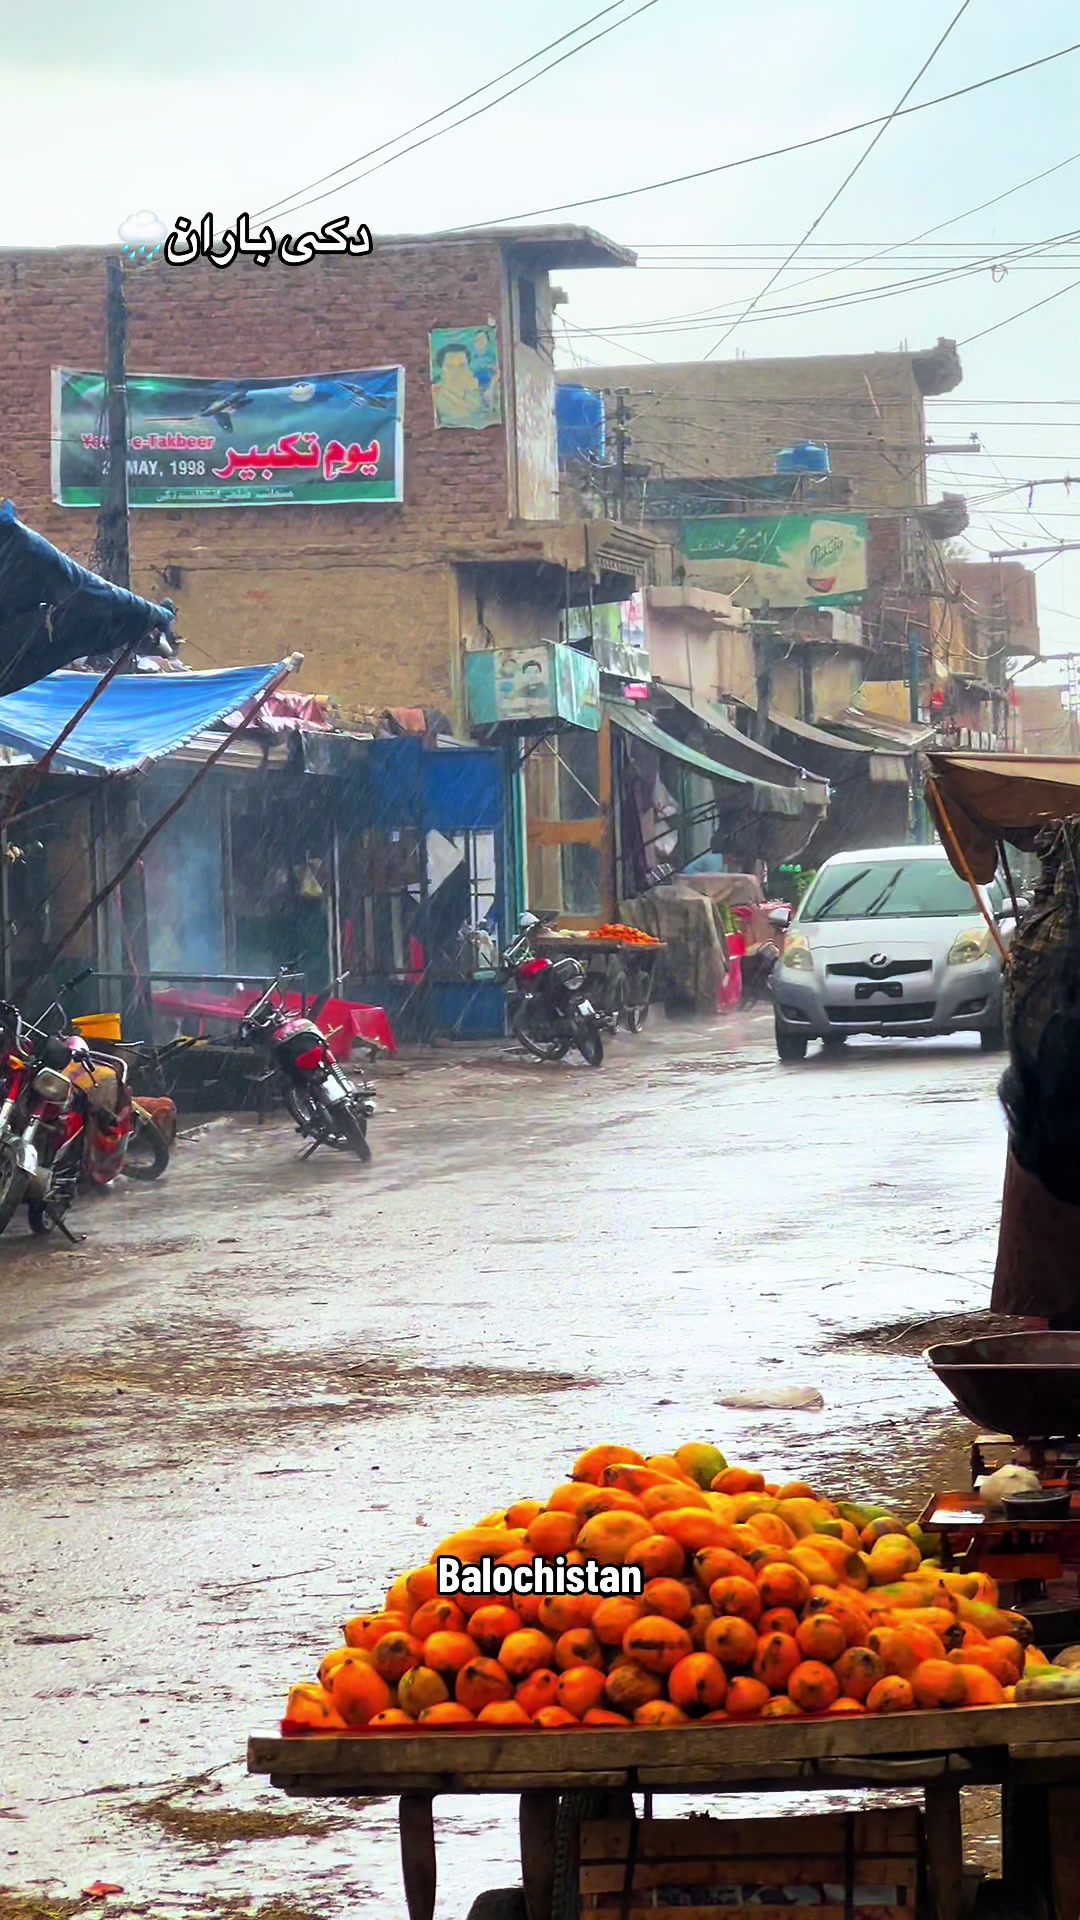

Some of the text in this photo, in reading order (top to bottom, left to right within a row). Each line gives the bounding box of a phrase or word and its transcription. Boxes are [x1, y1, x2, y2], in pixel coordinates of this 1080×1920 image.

[126, 460, 163, 477] MAY,
[170, 460, 205, 475] 1998
[212, 432, 380, 480] یوم تکبیر
